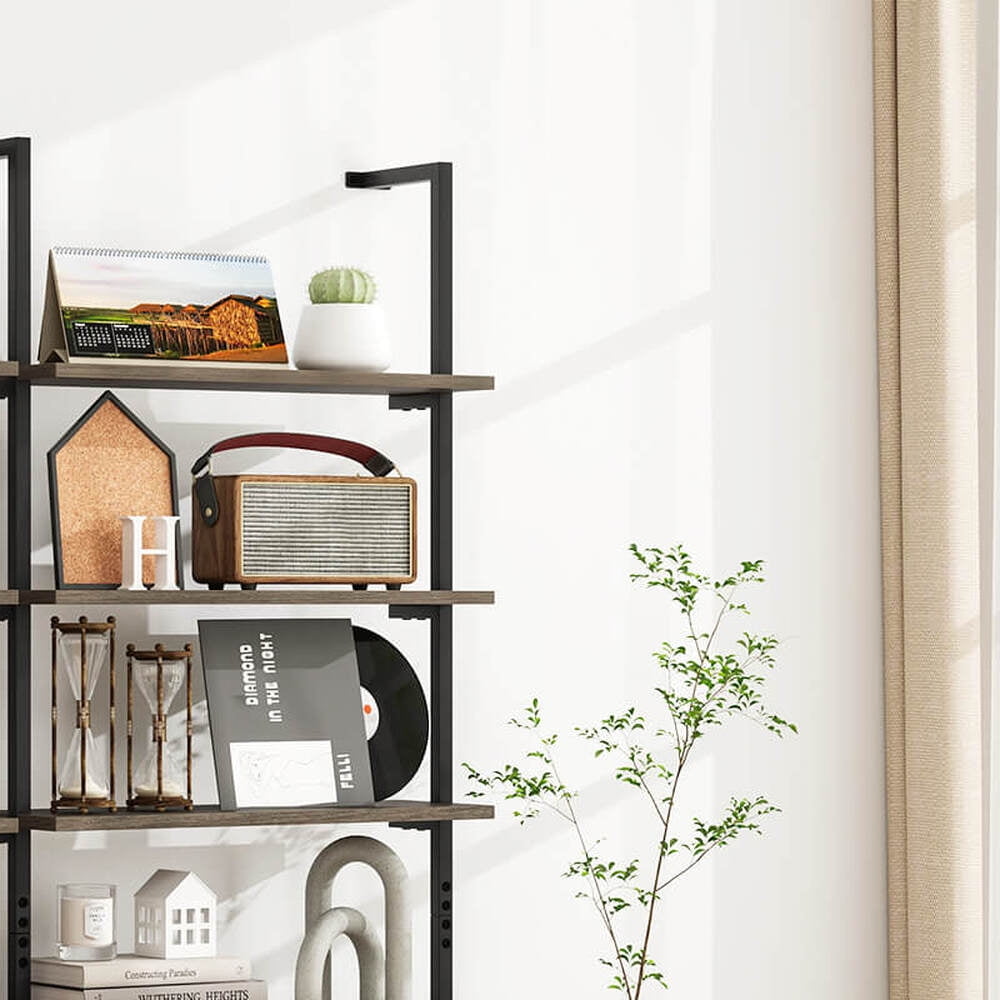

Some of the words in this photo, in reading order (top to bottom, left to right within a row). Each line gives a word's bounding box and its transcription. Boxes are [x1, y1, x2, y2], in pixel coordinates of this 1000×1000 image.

[239, 644, 259, 706] DIAMOND
[265, 682, 281, 705] THE
[267, 710, 283, 722] IN
